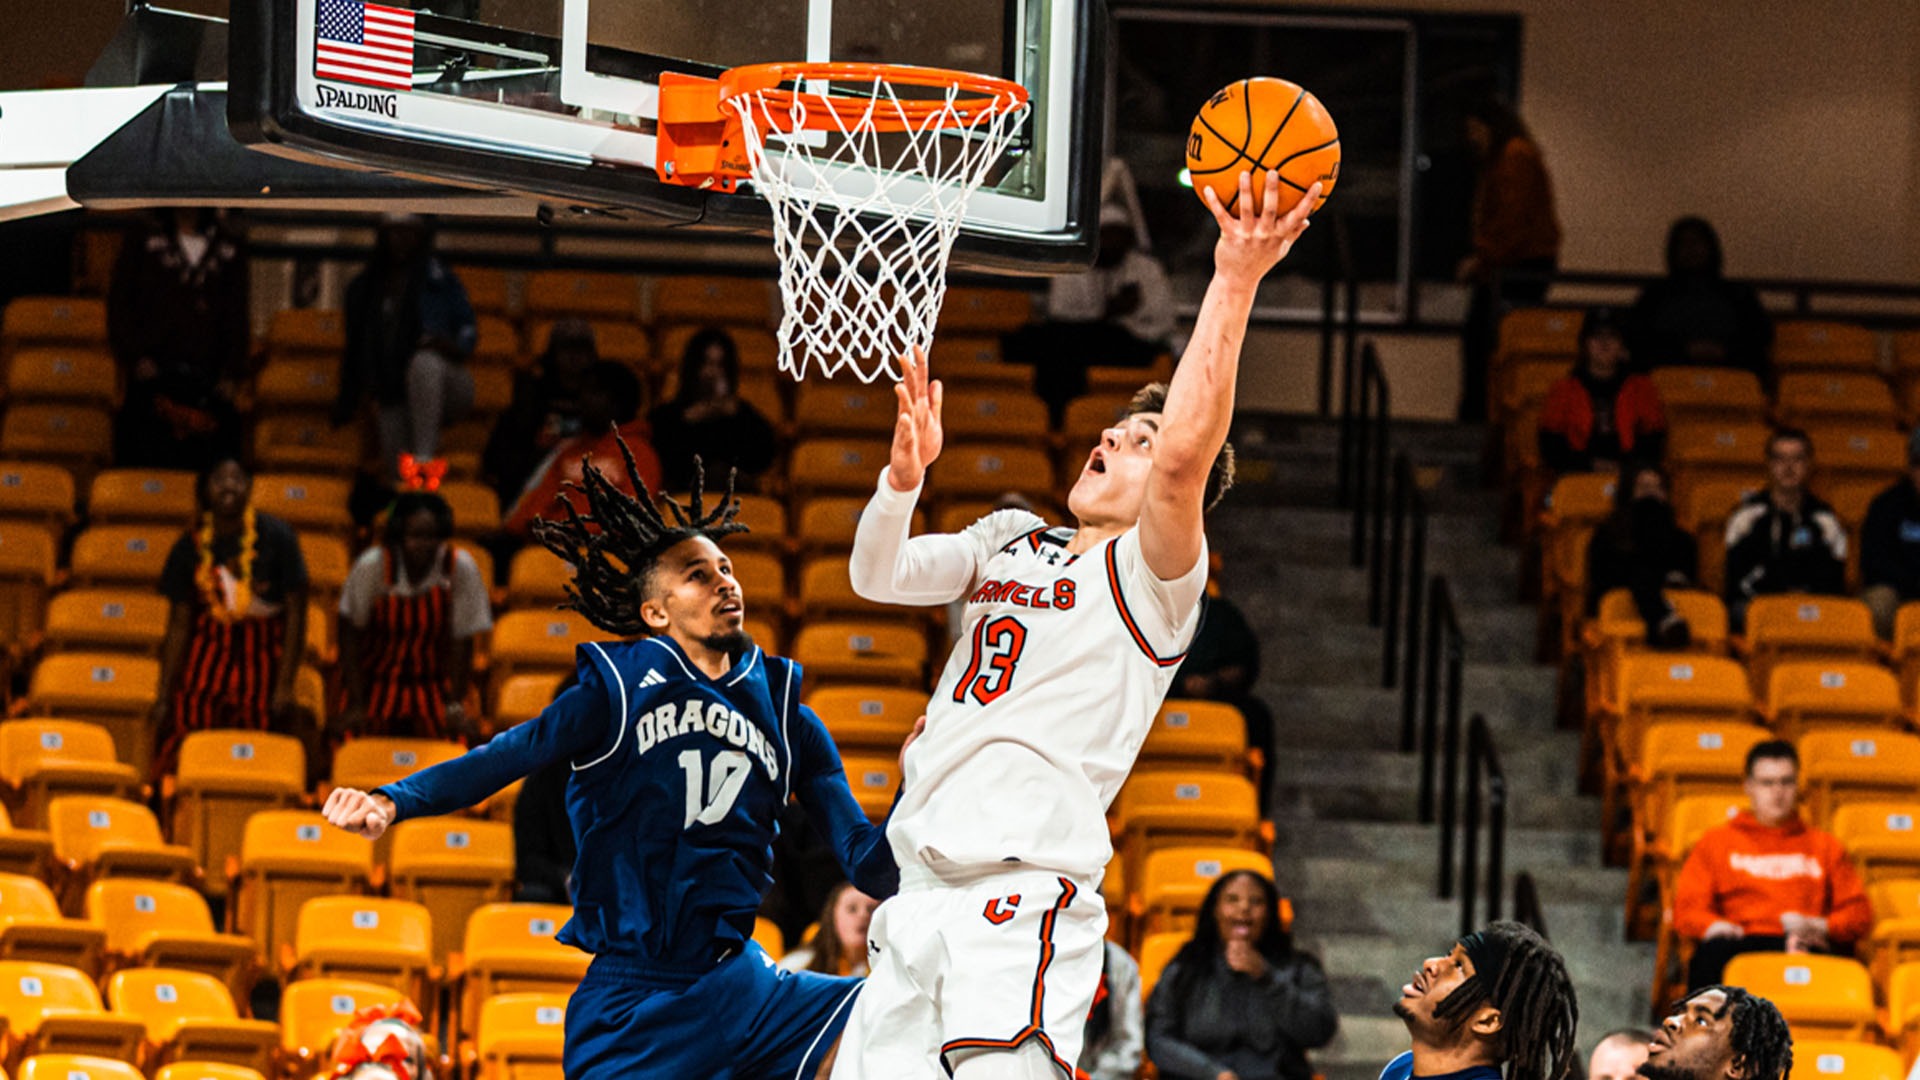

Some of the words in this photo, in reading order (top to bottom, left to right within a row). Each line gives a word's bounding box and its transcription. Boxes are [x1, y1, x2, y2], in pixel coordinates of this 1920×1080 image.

[315, 84, 398, 118] SPALDING
[952, 614, 1028, 706] 13
[635, 699, 779, 781] DRAGONS
[677, 749, 752, 831] 10
